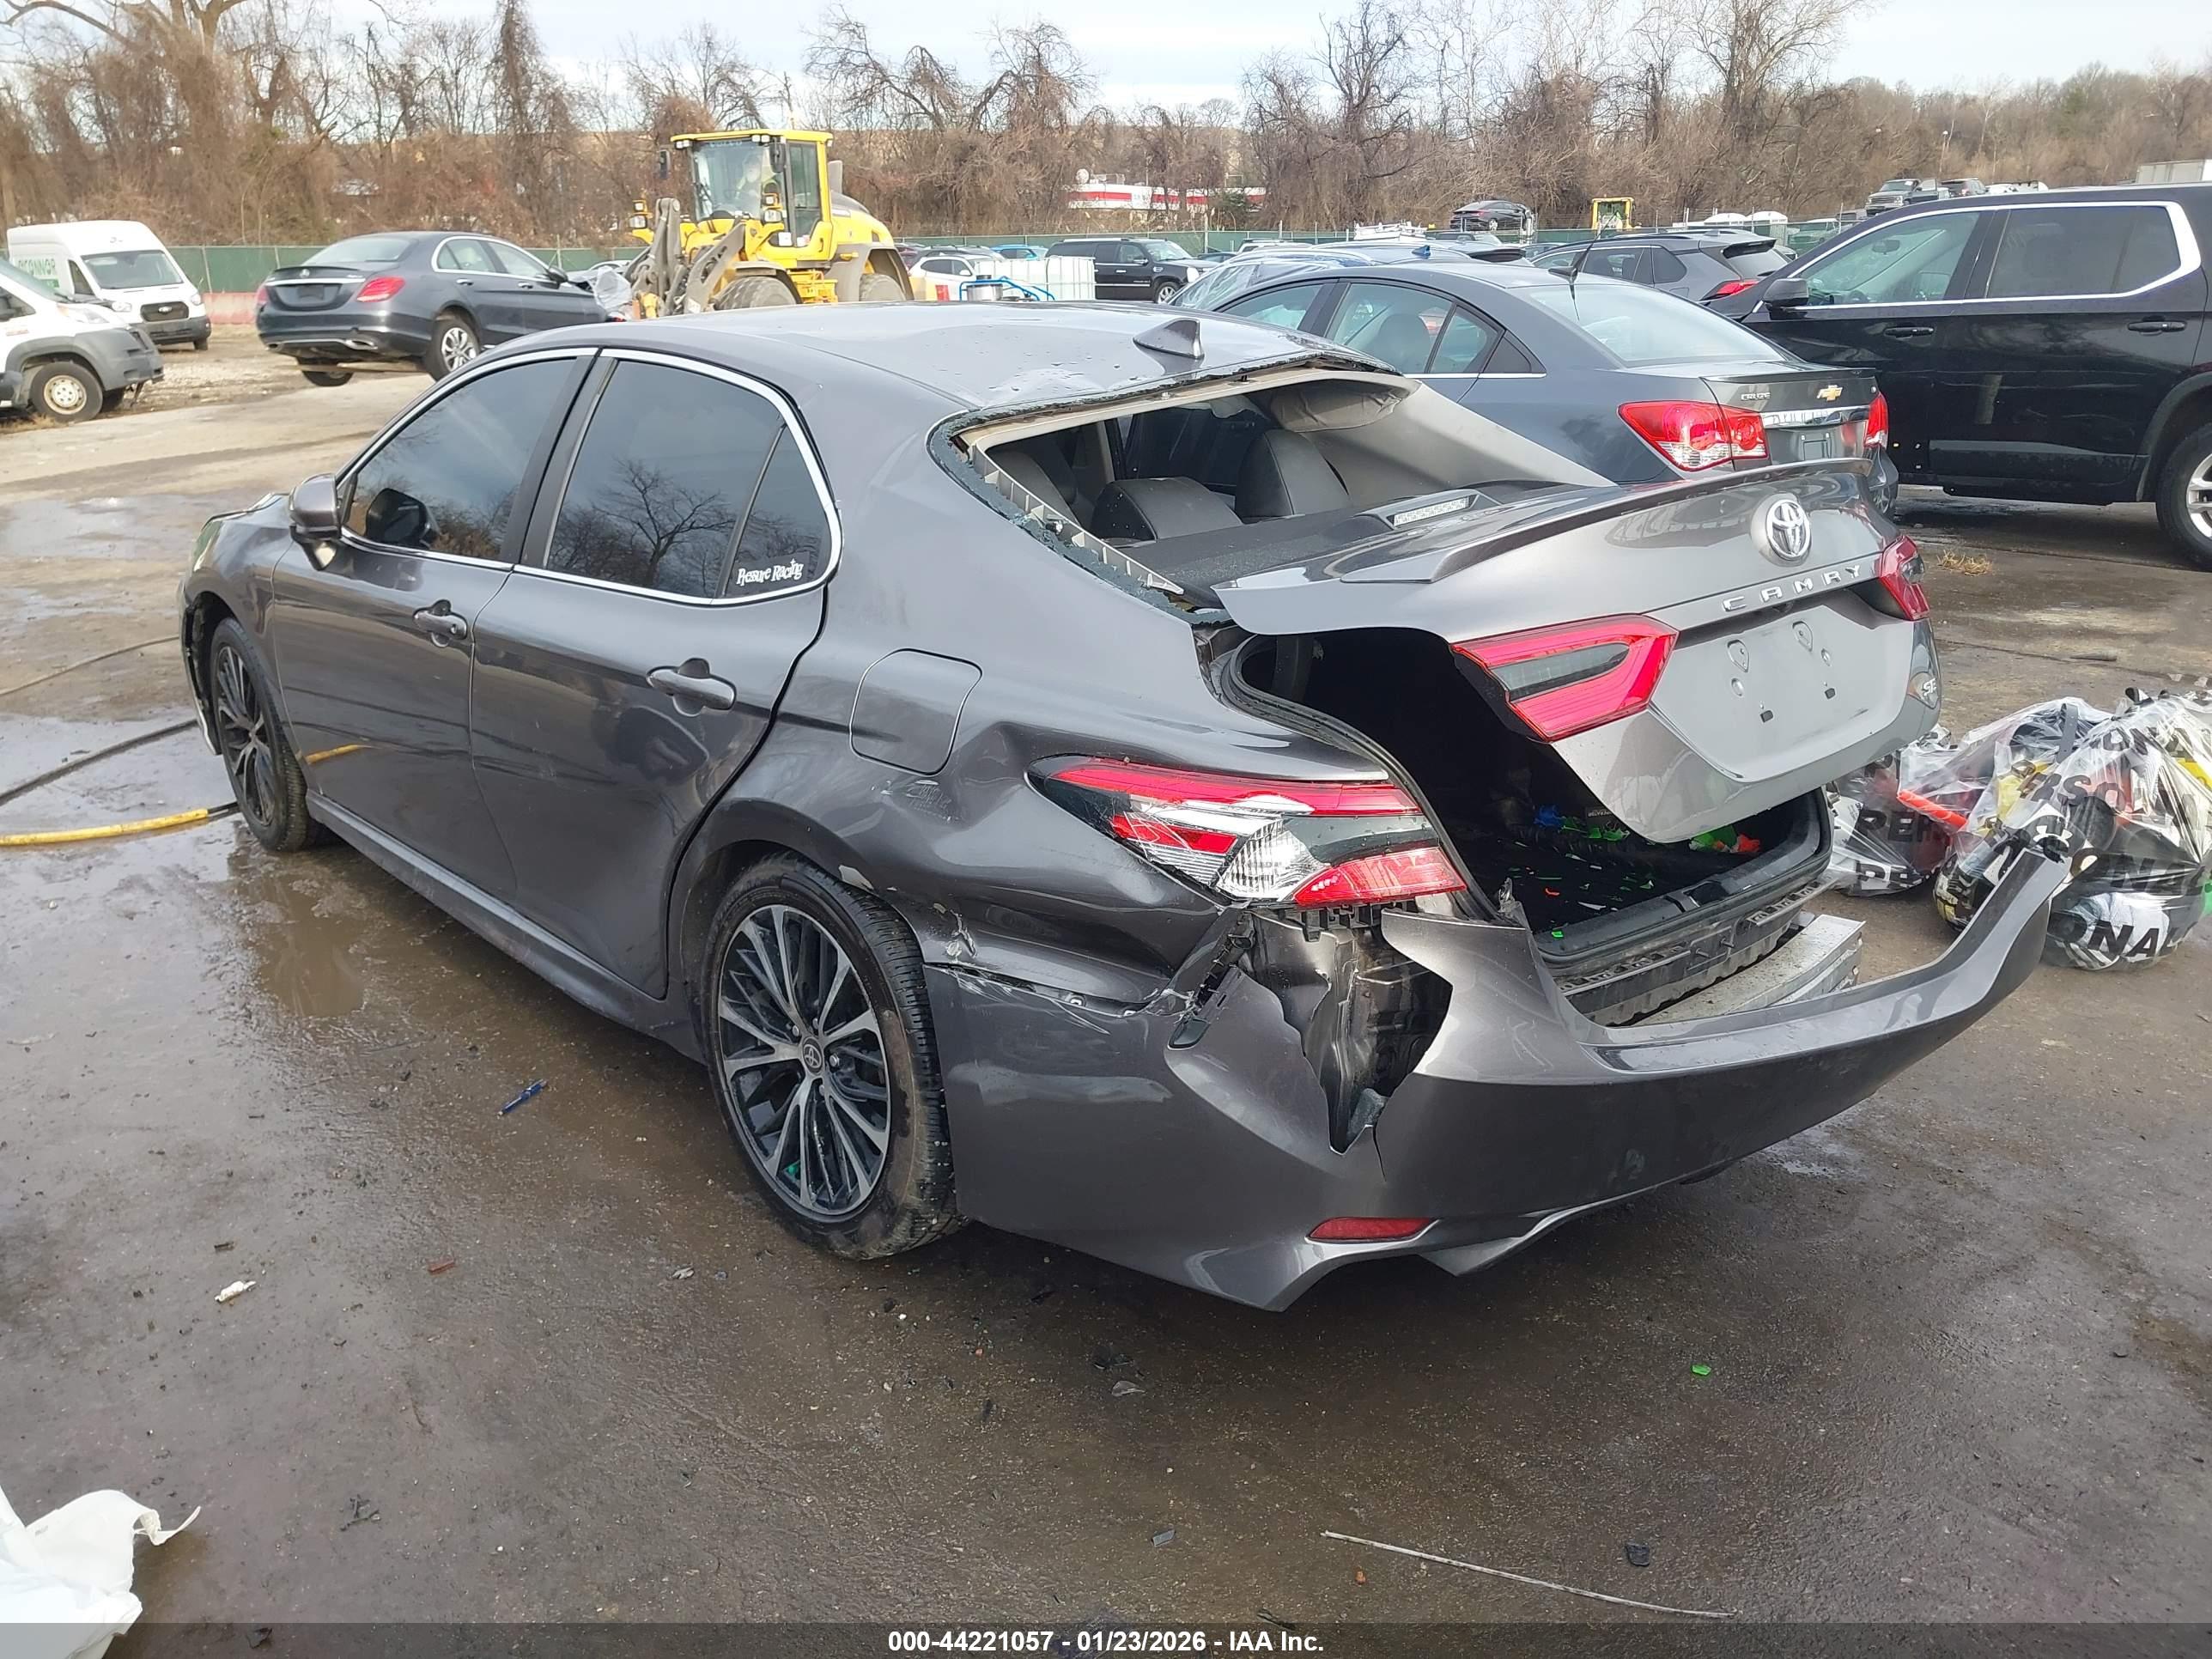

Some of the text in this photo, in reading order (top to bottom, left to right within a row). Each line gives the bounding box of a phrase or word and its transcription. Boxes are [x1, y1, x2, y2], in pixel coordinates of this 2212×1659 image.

[770, 558, 805, 580] Racing
[1723, 564, 1861, 612] CAMRY
[1923, 678, 1937, 696] SE
